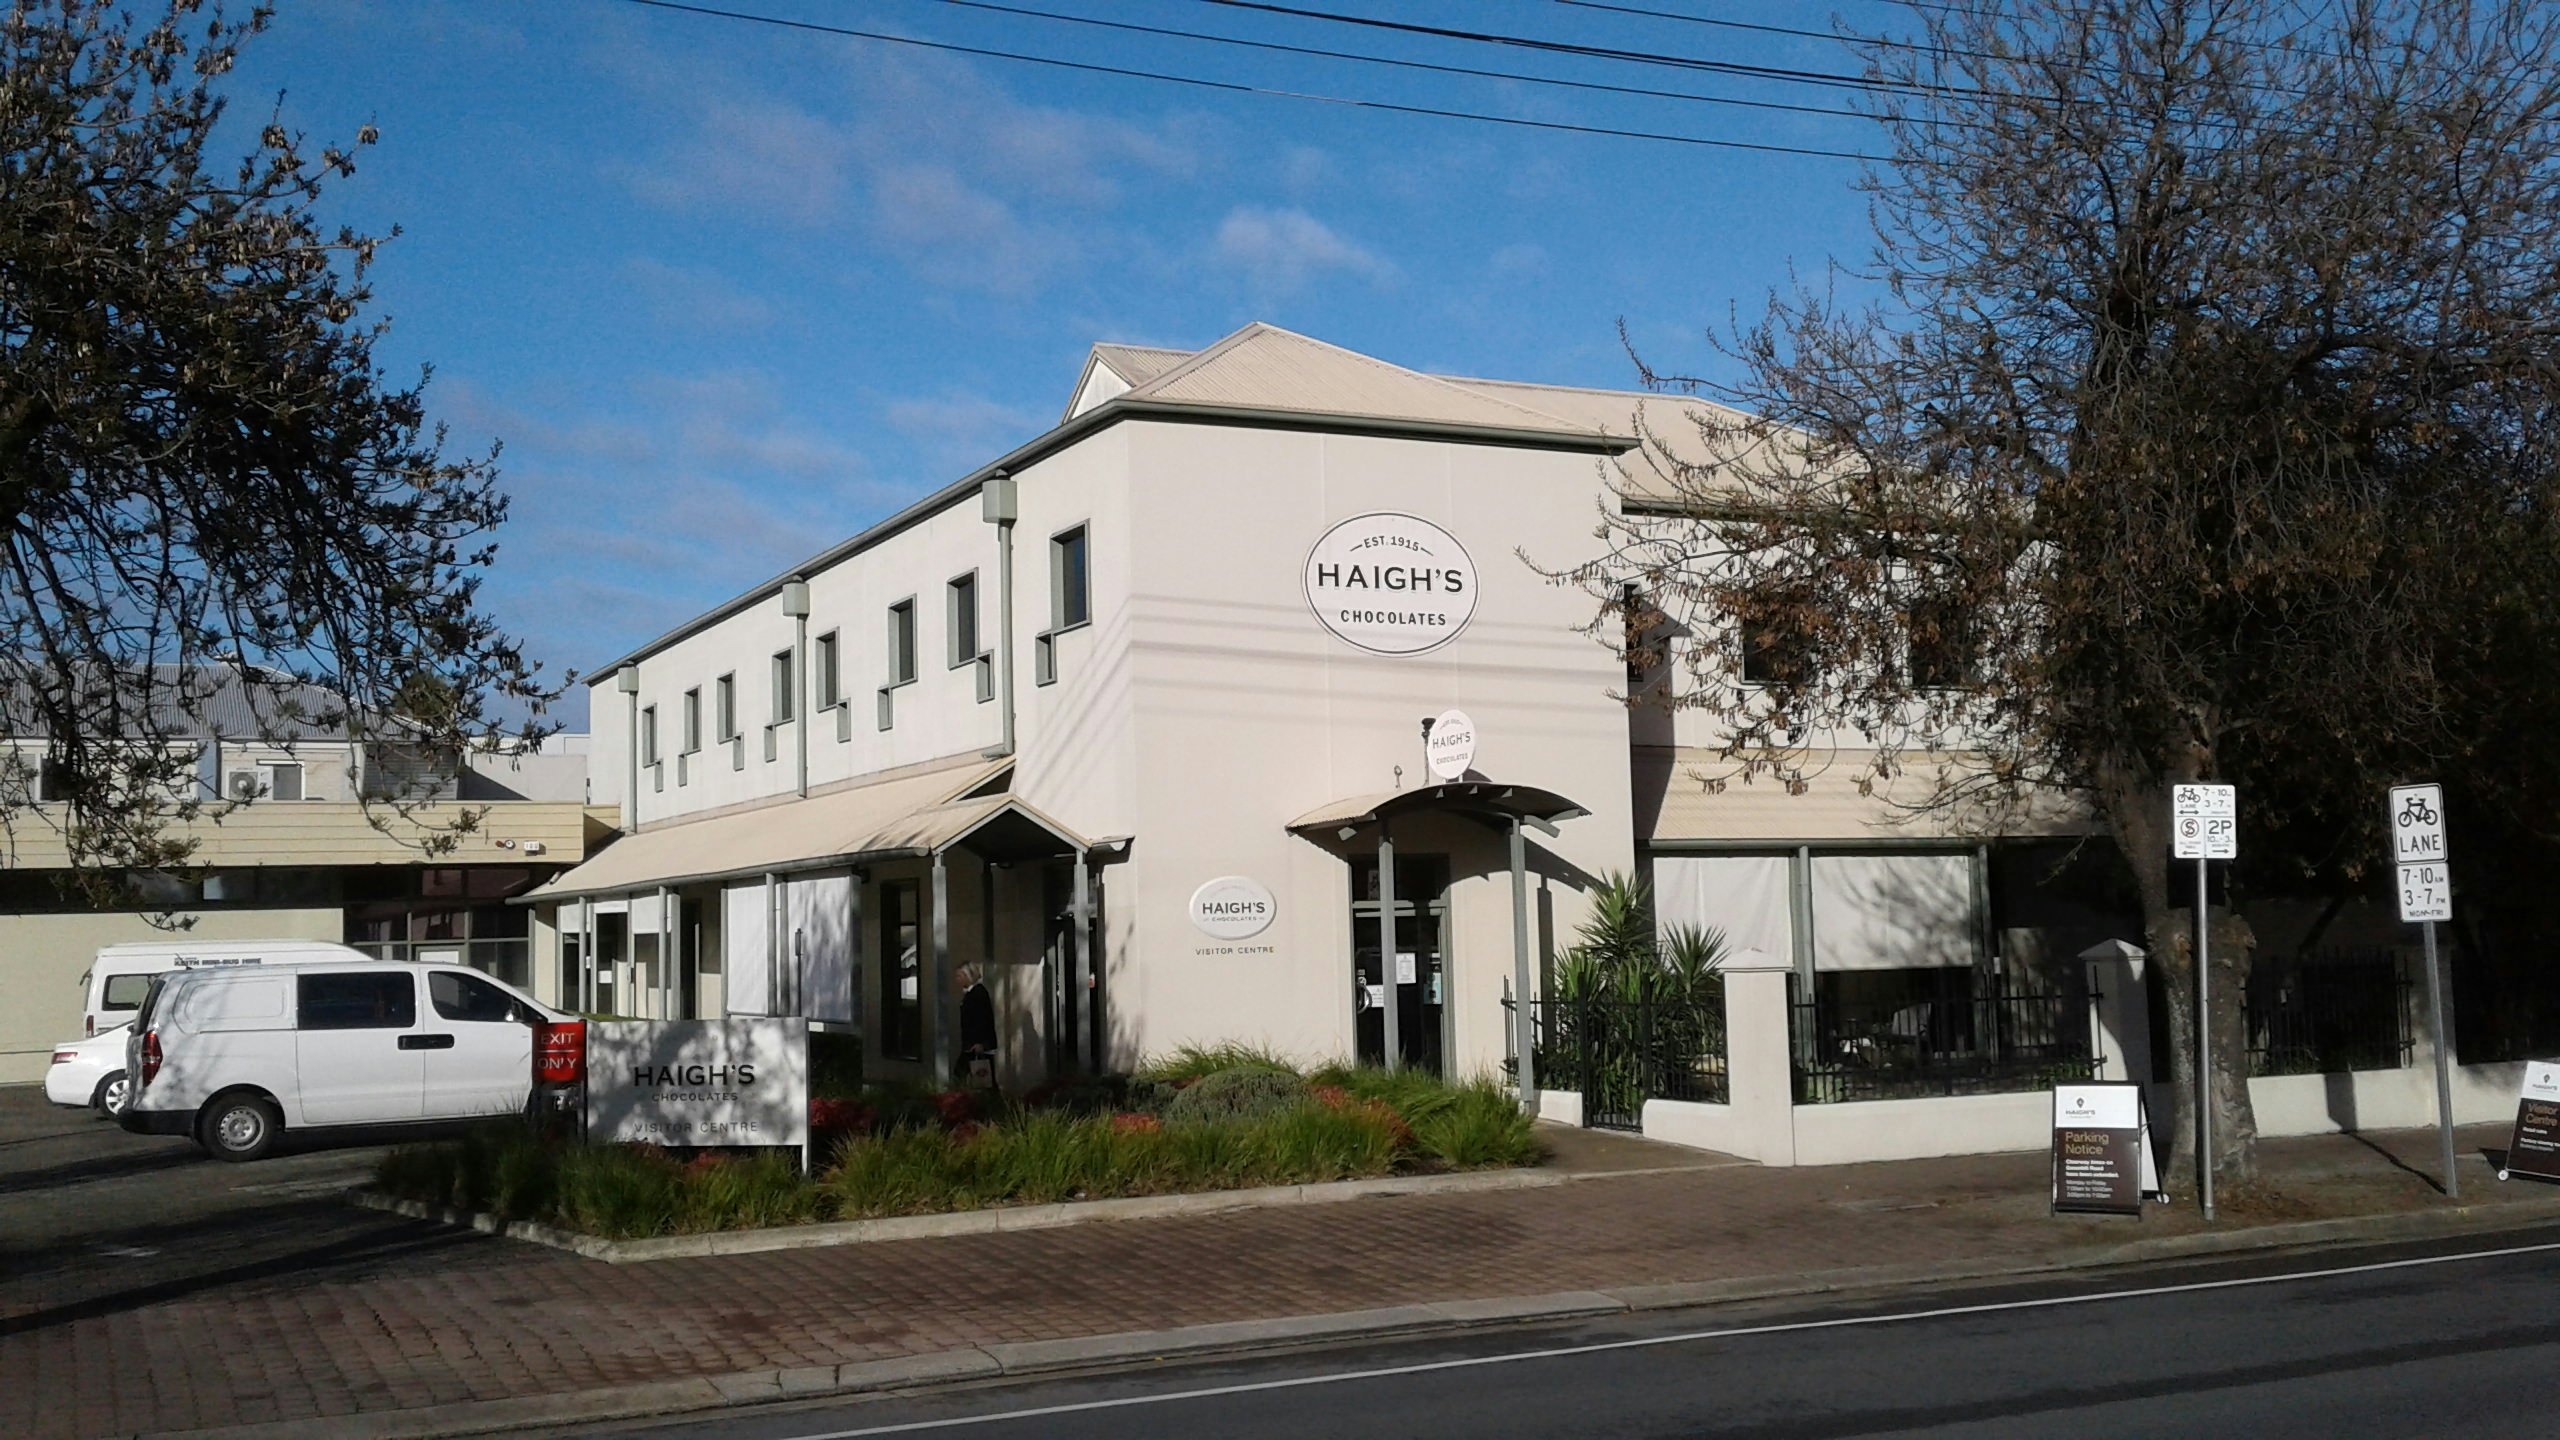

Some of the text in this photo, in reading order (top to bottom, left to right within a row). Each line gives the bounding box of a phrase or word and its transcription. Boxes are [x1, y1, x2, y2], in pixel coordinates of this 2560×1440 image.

[1318, 563, 1463, 593] HAIGH'S
[1341, 610, 1446, 625] CHOCOLATES
[1432, 732, 1471, 749] HAIGH'S
[2208, 820, 2232, 835] 2P
[2400, 834, 2440, 852] LANE
[1202, 902, 1265, 915] HAIGH'S
[1195, 946, 1274, 956] VISITOR CENTRE
[541, 1033, 575, 1045] EXIT
[634, 1065, 755, 1087] HAIGH'S
[651, 1092, 739, 1102] CHOCOLATES
[634, 1121, 758, 1133] VISITOR CENTRE
[2065, 1132, 2109, 1146] Parking
[2065, 1144, 2104, 1155] Notice
